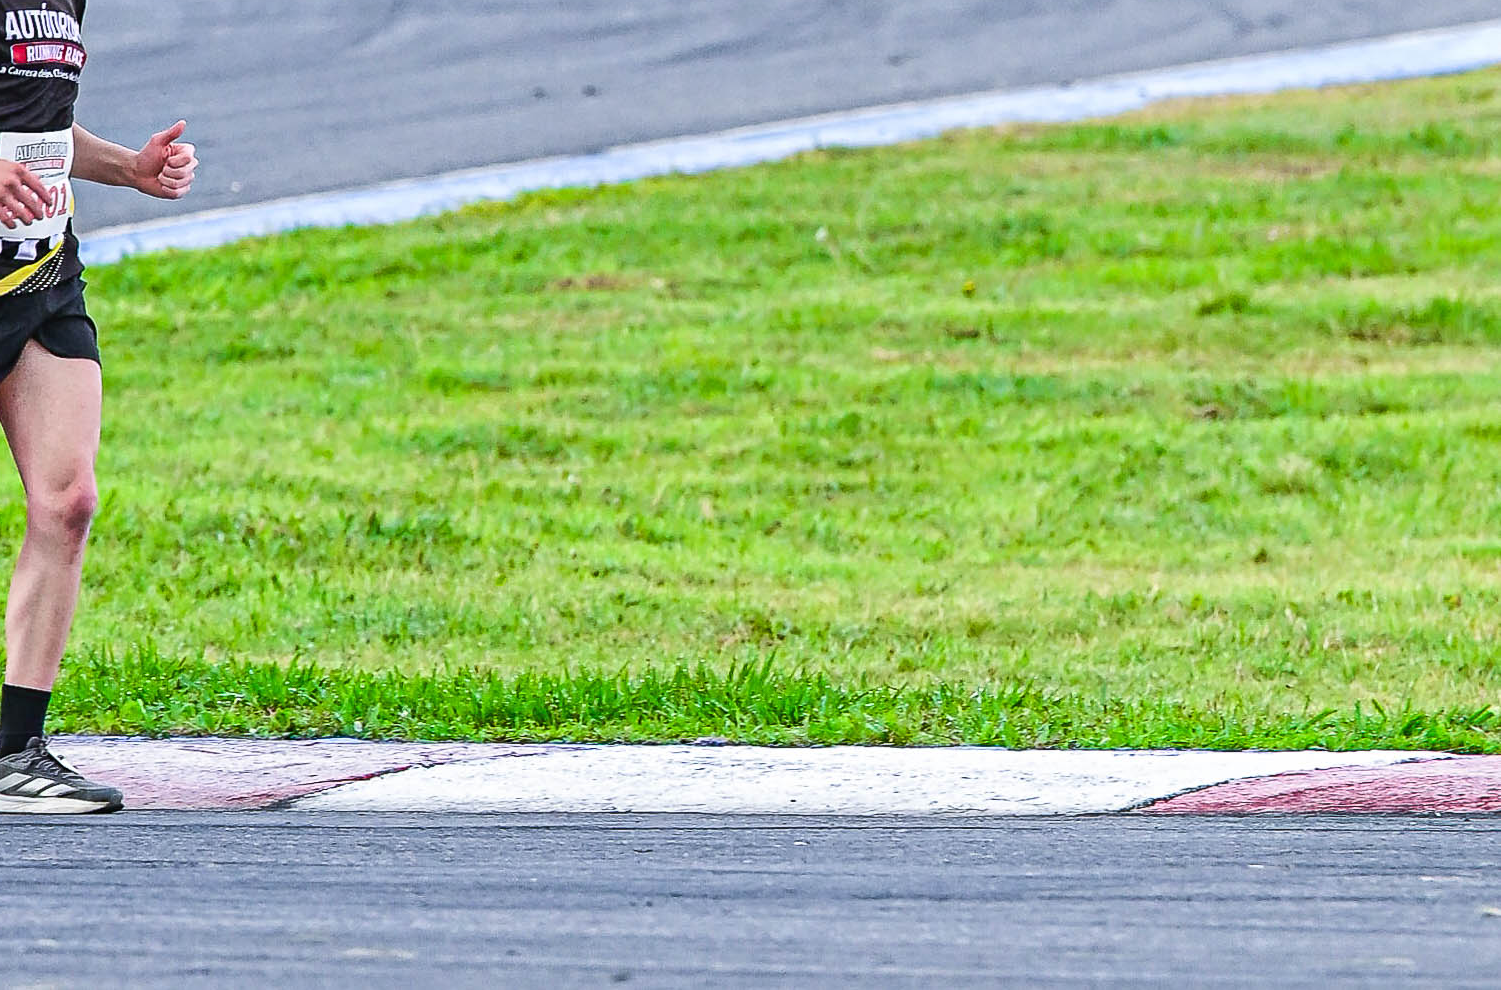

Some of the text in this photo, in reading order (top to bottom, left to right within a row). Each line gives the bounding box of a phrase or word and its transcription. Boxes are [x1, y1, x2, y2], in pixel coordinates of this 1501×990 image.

[5, 3, 82, 43] AUTÓDROM
[26, 44, 85, 68] RUNNING RACE
[8, 67, 37, 77] Carrera
